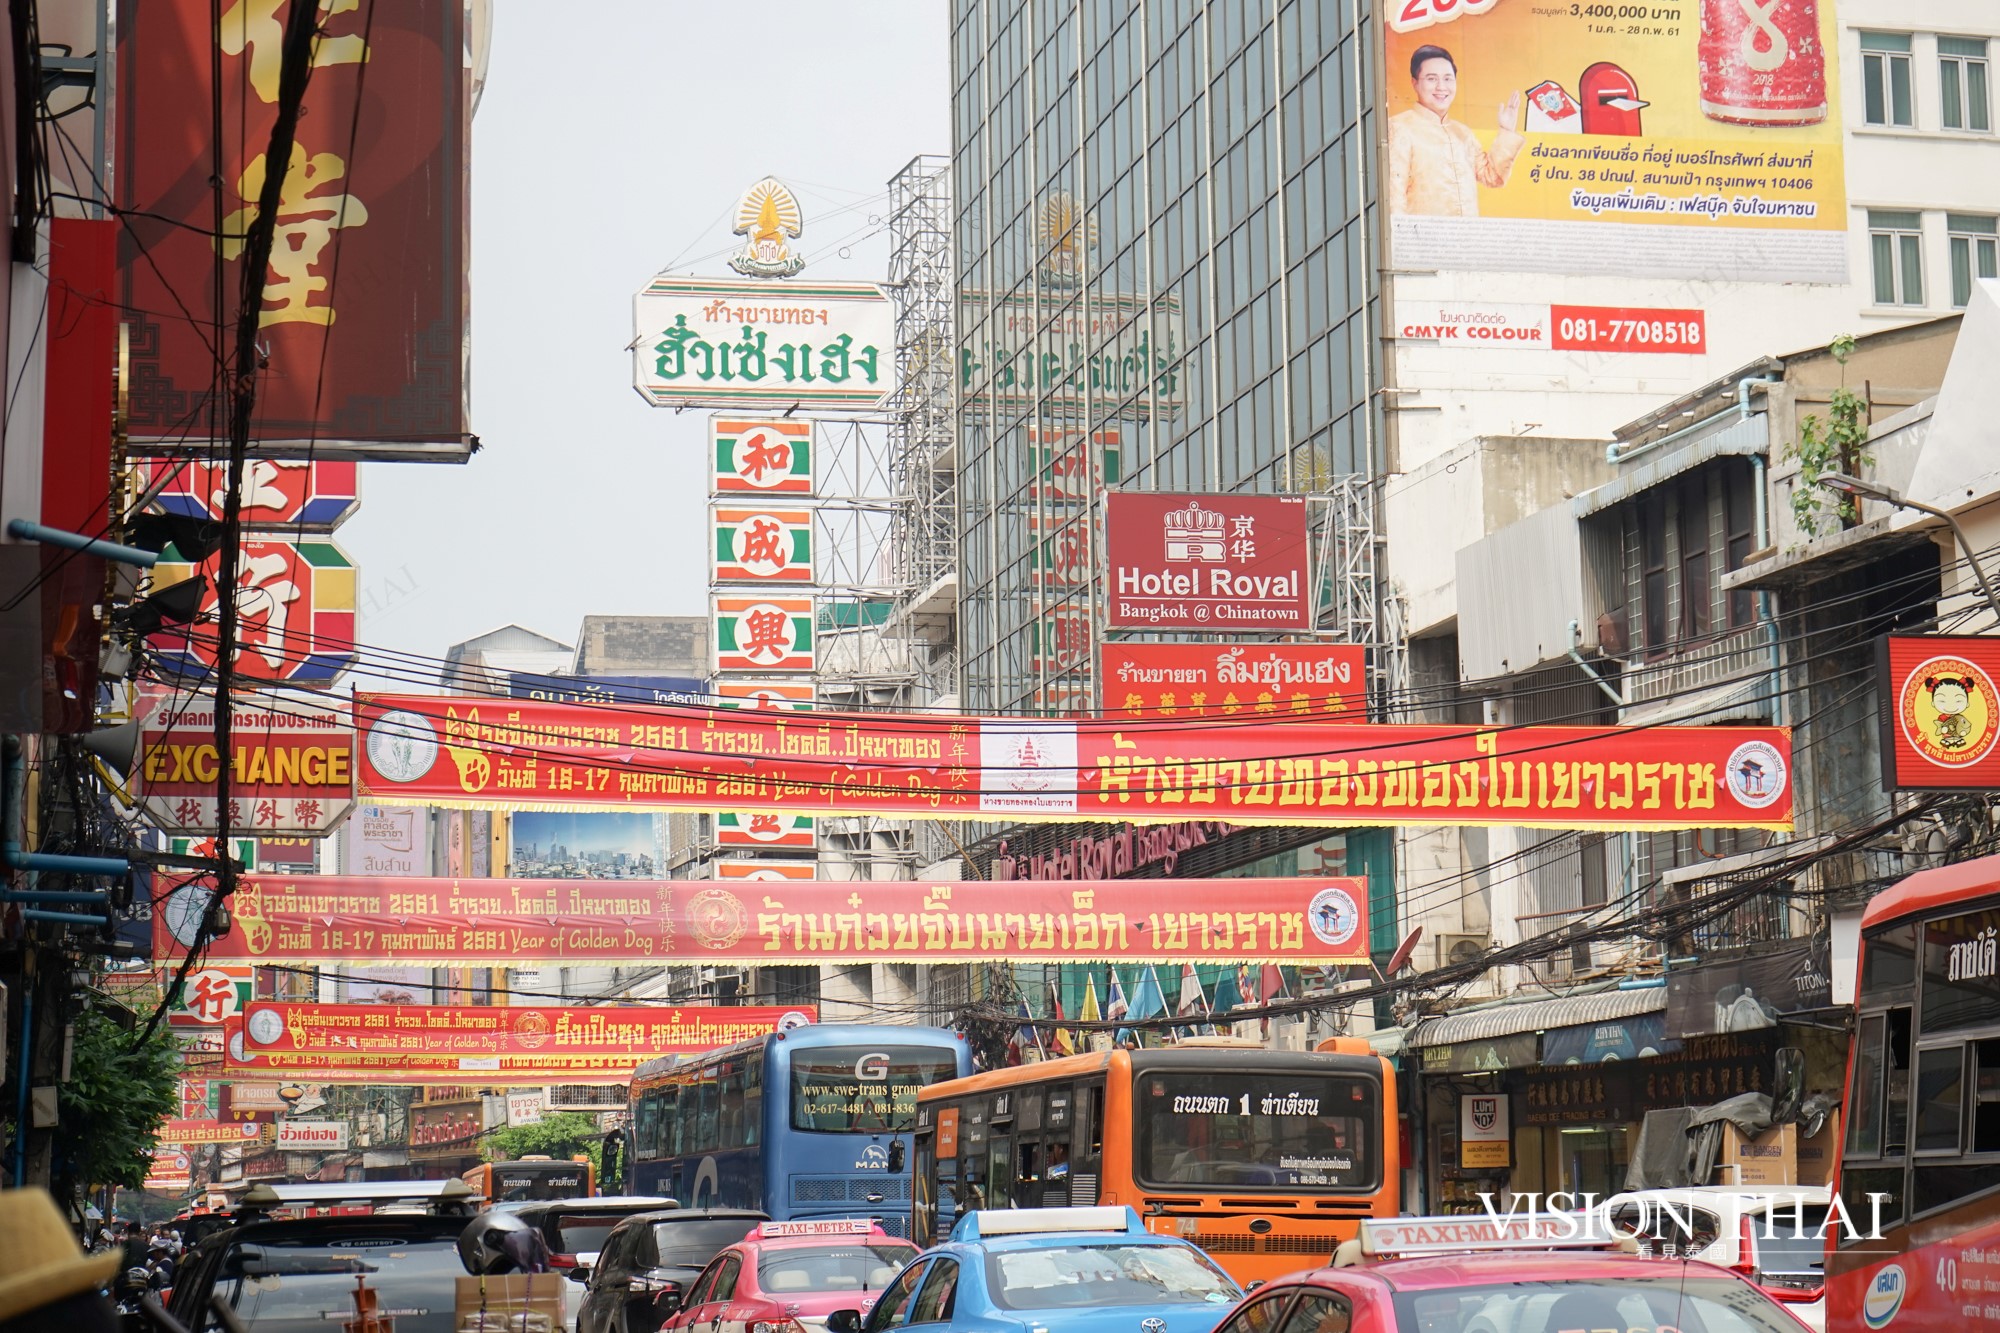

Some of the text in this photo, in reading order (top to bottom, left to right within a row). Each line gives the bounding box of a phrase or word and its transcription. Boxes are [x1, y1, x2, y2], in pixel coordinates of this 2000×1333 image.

[1570, 4, 1647, 19] 3,400,000
[1651, 8, 1681, 20] บาท
[1587, 24, 1593, 33] 1
[1595, 24, 1616, 34] ม.ค.
[1627, 25, 1640, 34] 28
[1668, 27, 1680, 36] 61
[1531, 143, 1814, 168] ส่งฉลากเขียนชื่อ ที่อยู่ เบอร์โทรศัพท์ ส่งมาที่
[1530, 169, 1541, 183] ตู้
[1545, 170, 1573, 182] ปณ.
[1579, 169, 1595, 181] 38
[1643, 172, 1702, 186] สนามเป้า
[1705, 175, 1766, 191] กรุงเทพฯ
[1772, 177, 1813, 190] 10406
[1572, 187, 1666, 213] ข้อมูลเพิ่มเติม
[1679, 195, 1728, 219] เฟสบุ๊ค
[1732, 196, 1815, 217] จับใจมหาชน
[703, 300, 829, 326] ห้างขายทอง
[1439, 310, 1506, 324] โฆษณาติดต่อ
[1403, 325, 1542, 341] CMYK COLOUR
[1560, 318, 1700, 345] 081-7708518
[654, 313, 880, 384] ฮั่วเซ่งเฮง
[1229, 515, 1256, 563] 京华
[1118, 567, 1298, 599] Hotel Royal
[1120, 602, 1299, 623] Bangkok @ Chinatown
[1117, 646, 1350, 694] ร้านขายยา ลิ้มซุ่นเฮง
[630, 725, 689, 750] 2561
[145, 744, 350, 785] EXCHANGE
[1096, 729, 1717, 810] ห้างขายทองทองใบเยาวราช
[497, 751, 941, 807] วันที่ 16-17 กุมภาพันธ์ 2561 Year of Golden Dog
[363, 821, 395, 830] ศาสตร์
[363, 830, 403, 838] พระราชา
[1031, 839, 1078, 879] Hotel
[1081, 822, 1134, 879] Royal
[389, 894, 440, 915] 2561
[655, 884, 677, 954] 新年快乐
[757, 886, 1130, 951] ร้านก๋วยจั๊บนายเอ็ก
[1148, 911, 1305, 951] เยาวราช
[278, 916, 654, 957] วันที่ 16-17 กุมภาพันธ์ 2561 Year of Golden Dog
[1947, 926, 1998, 983] สายใต้
[364, 1014, 390, 1028] 2561
[400, 1035, 423, 1049] 2561
[425, 1033, 442, 1051] Year
[443, 1032, 452, 1052] of
[455, 1033, 480, 1050] Golden
[481, 1033, 498, 1051] Dog
[855, 1052, 891, 1081] G
[802, 1083, 888, 1097] www.swe-trans
[804, 1103, 865, 1114] 02-617-4481
[1173, 1092, 1320, 1117] ถนนตก 1 ท่าเตียน
[855, 1161, 889, 1169] MAN
[781, 1222, 854, 1234] TAXI-METER
[1149, 1218, 1156, 1233] 1
[1176, 1218, 1196, 1234] 74
[1397, 1221, 1562, 1245] TAXI-METER
[1936, 1257, 1957, 1292] 40
